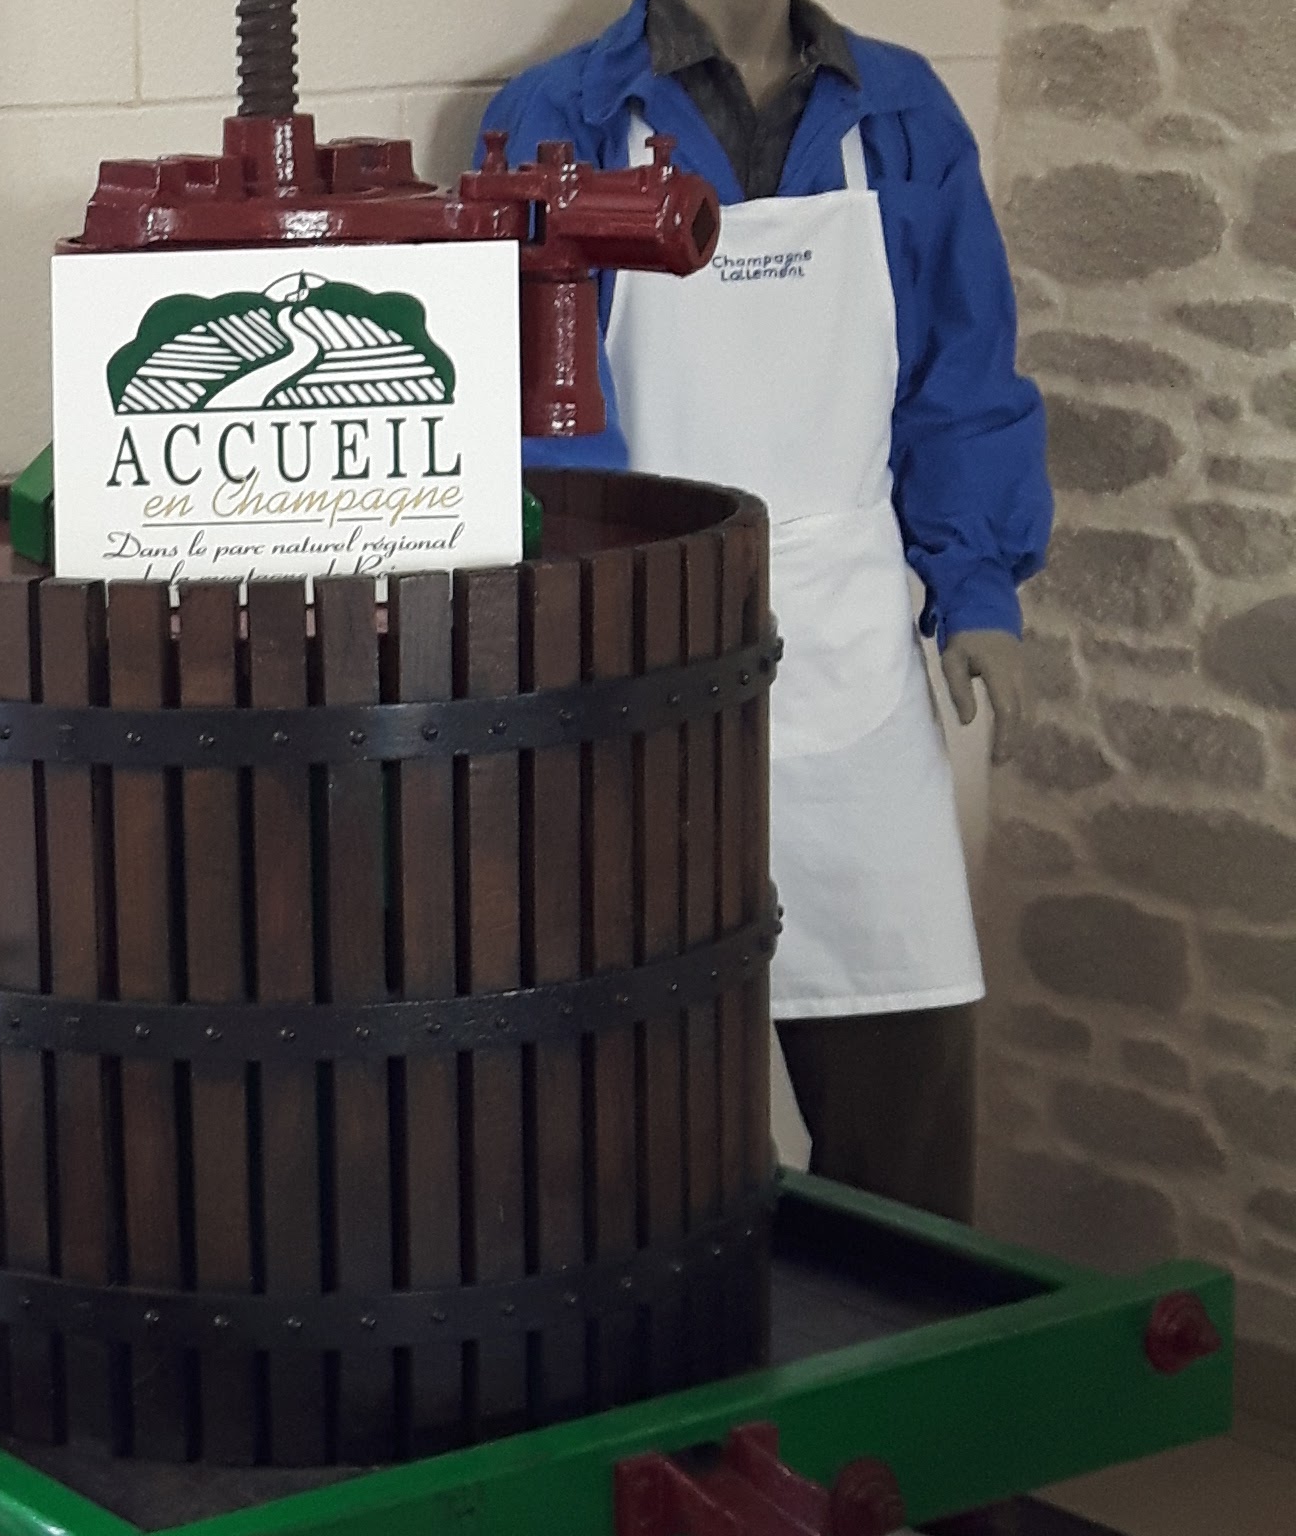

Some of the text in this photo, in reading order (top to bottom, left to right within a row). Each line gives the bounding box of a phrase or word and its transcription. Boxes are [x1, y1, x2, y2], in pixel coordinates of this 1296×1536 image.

[712, 249, 812, 269] Champagne
[721, 266, 805, 282] Lallement
[106, 415, 463, 488] ACCUEIL
[142, 467, 465, 529] en Champagne
[102, 521, 466, 564] Dans le parc naturel régional
